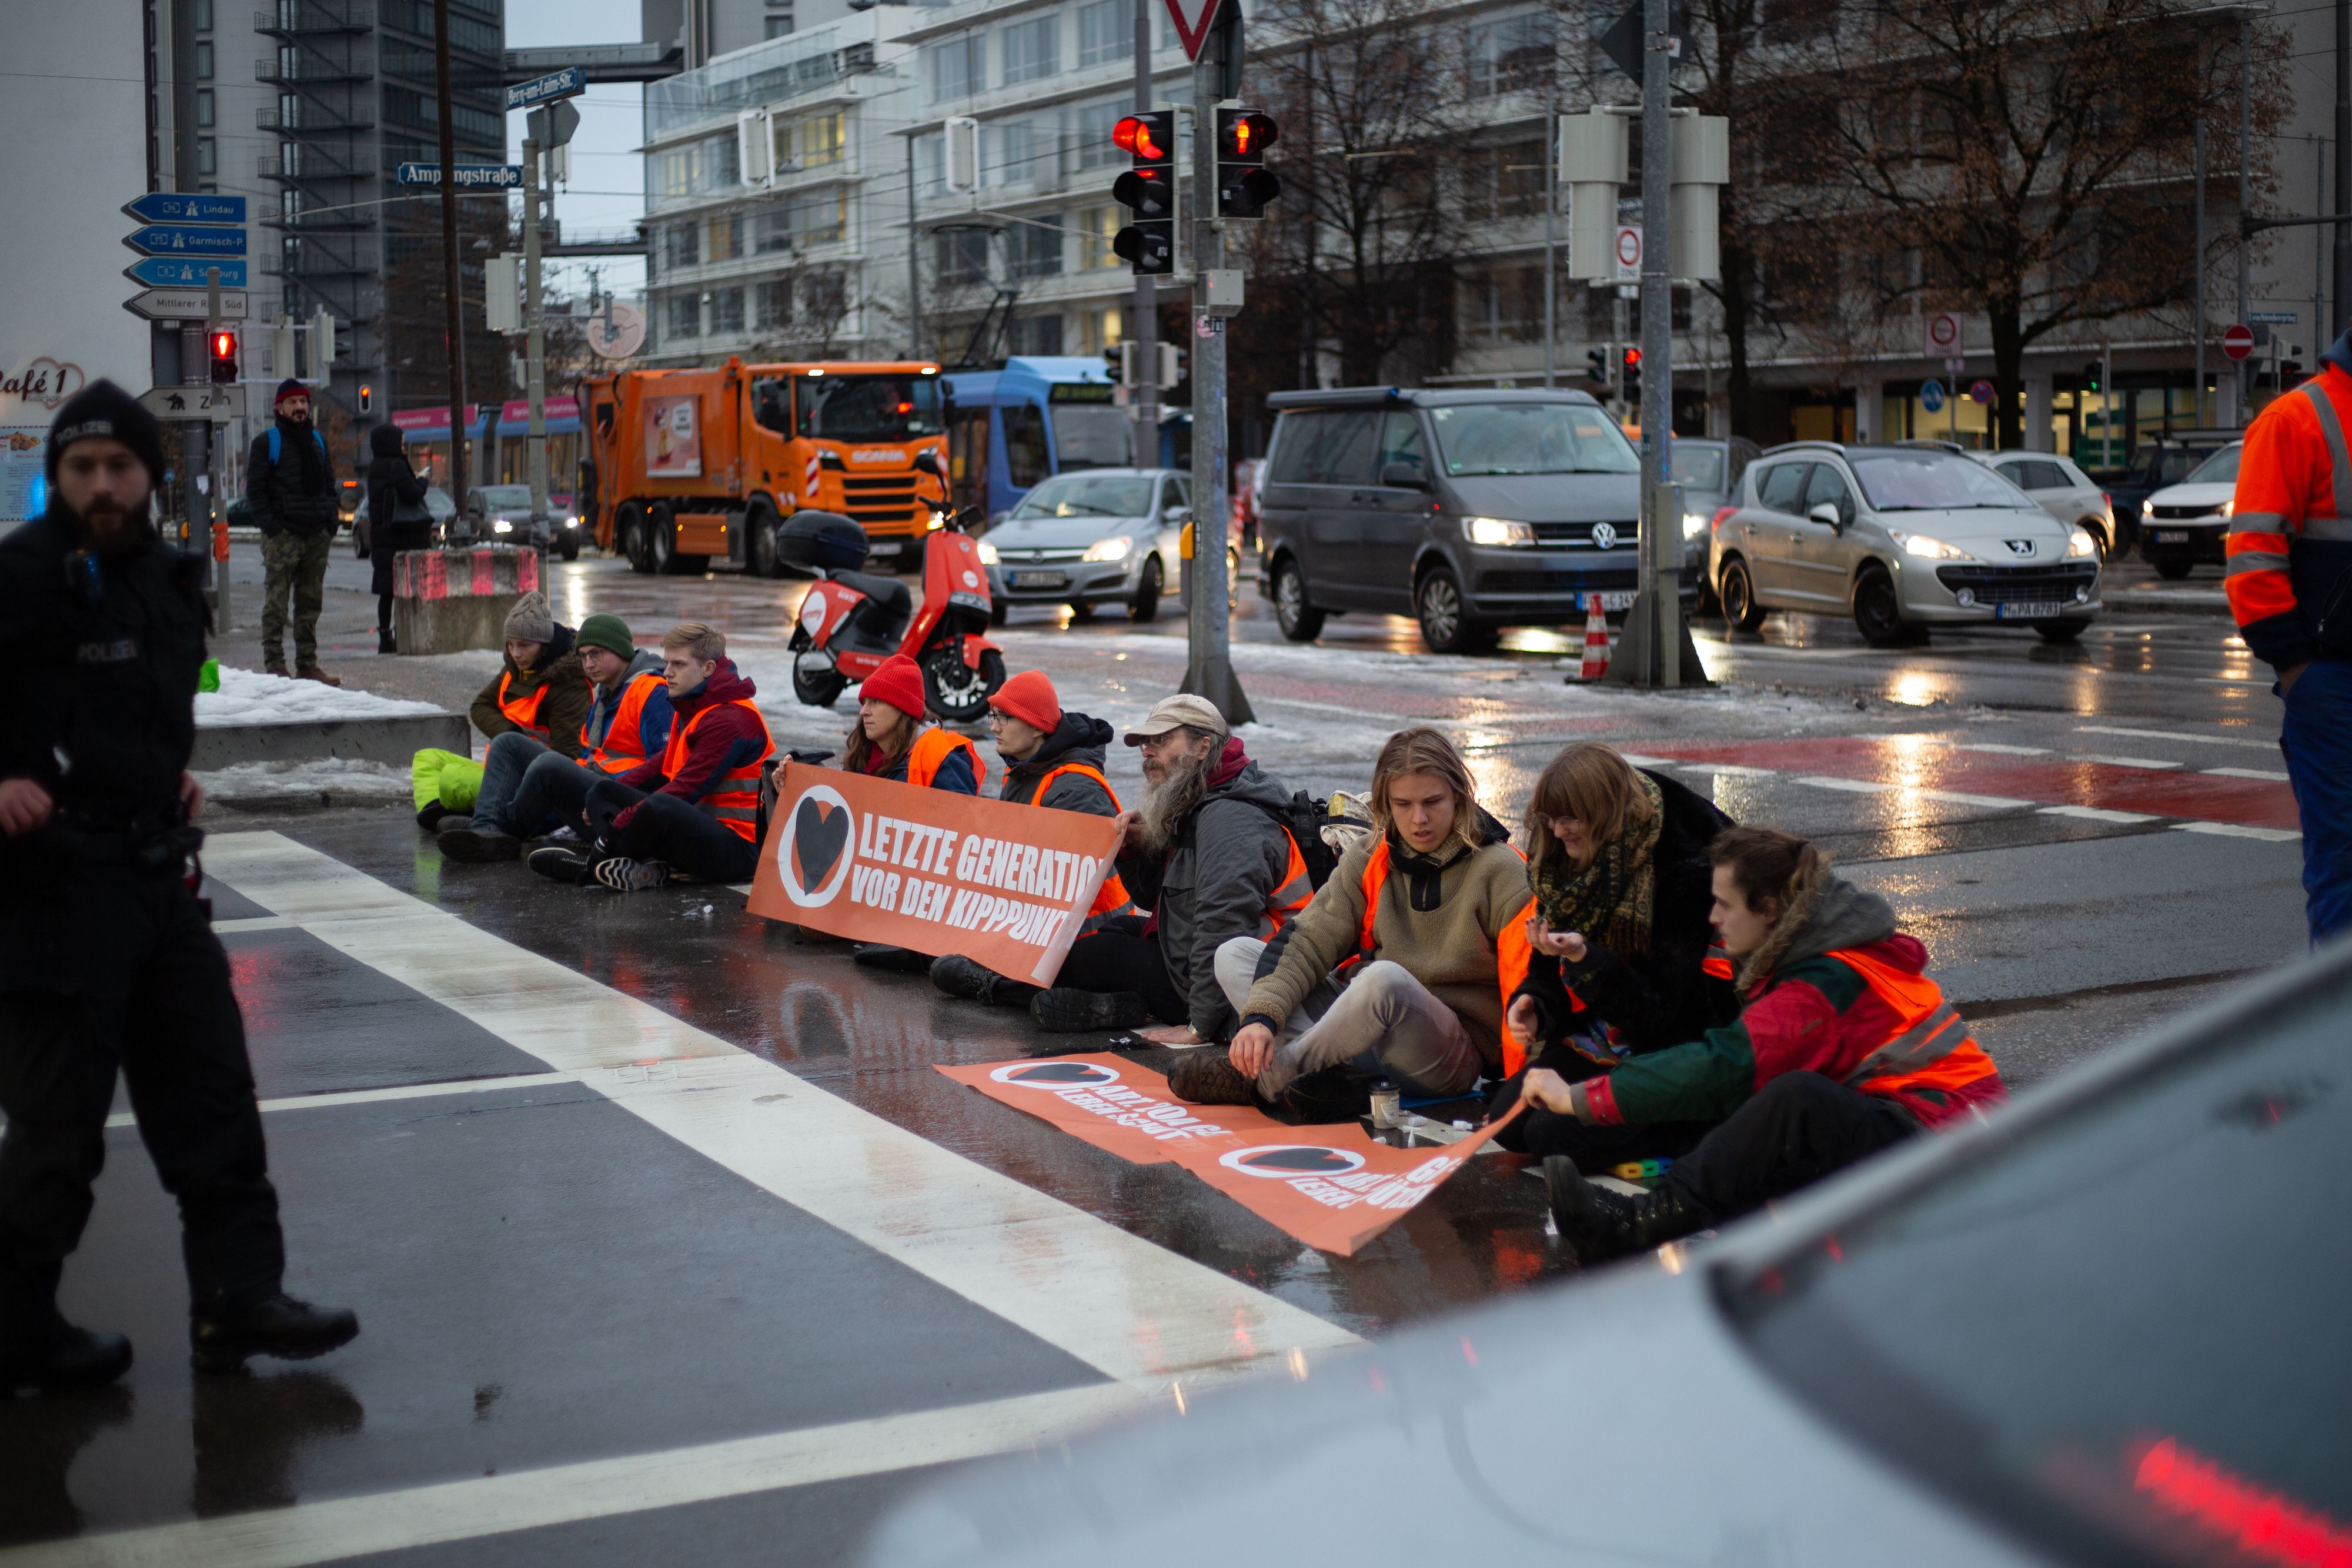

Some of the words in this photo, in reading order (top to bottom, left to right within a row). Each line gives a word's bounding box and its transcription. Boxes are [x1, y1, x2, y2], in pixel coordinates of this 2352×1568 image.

[507, 71, 573, 105] Berg-am-Laim-Str.
[407, 165, 517, 185] Ampngstraße
[203, 205, 234, 214] Lindau
[189, 236, 244, 246] Garmisch-P.
[156, 299, 196, 307] Mittlerer
[225, 300, 242, 309] Süd
[858, 813, 958, 876] LETZTE
[956, 834, 1105, 903] GENERATIO
[850, 864, 901, 911] VOR
[899, 877, 953, 922] DEN
[1054, 1088, 1121, 1115] LEBEN
